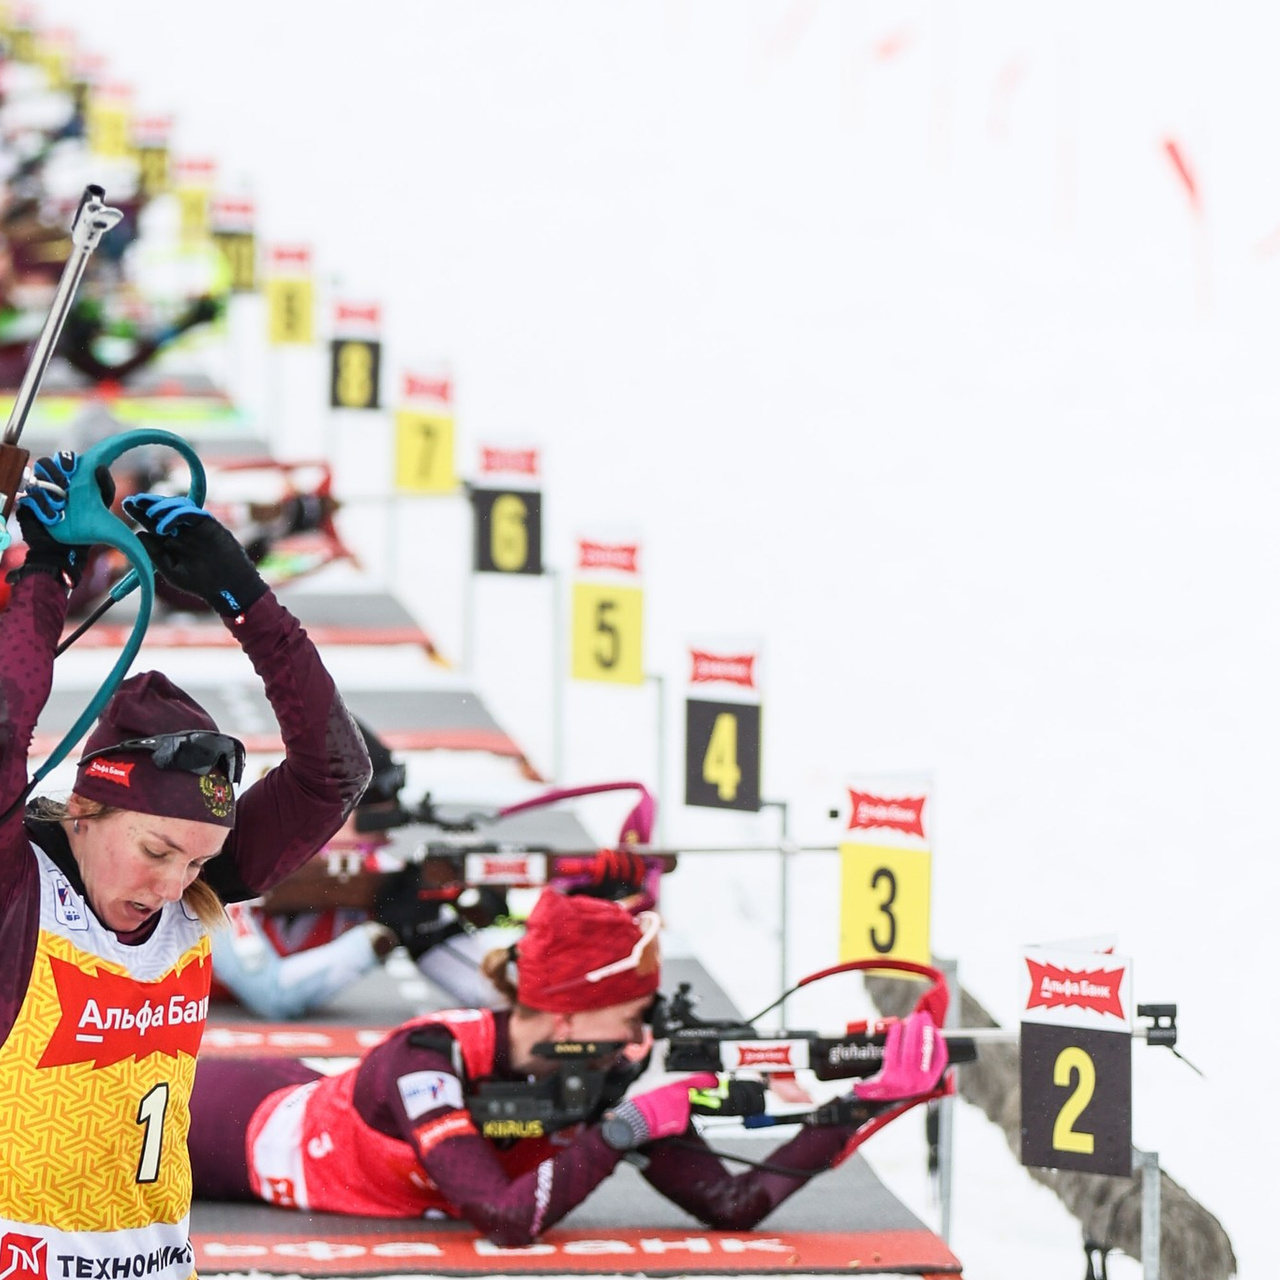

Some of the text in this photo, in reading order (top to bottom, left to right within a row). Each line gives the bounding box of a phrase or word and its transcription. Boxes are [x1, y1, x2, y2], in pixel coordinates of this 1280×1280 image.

[414, 424, 441, 480] 7
[489, 493, 529, 572] 6
[594, 598, 622, 672] 5
[702, 712, 742, 802] 4
[869, 867, 897, 954] 3
[76, 999, 164, 1043] Альфа
[1040, 975, 1112, 1000] Альфа Банк
[136, 1081, 169, 1184] 1
[1052, 1046, 1096, 1155] 2
